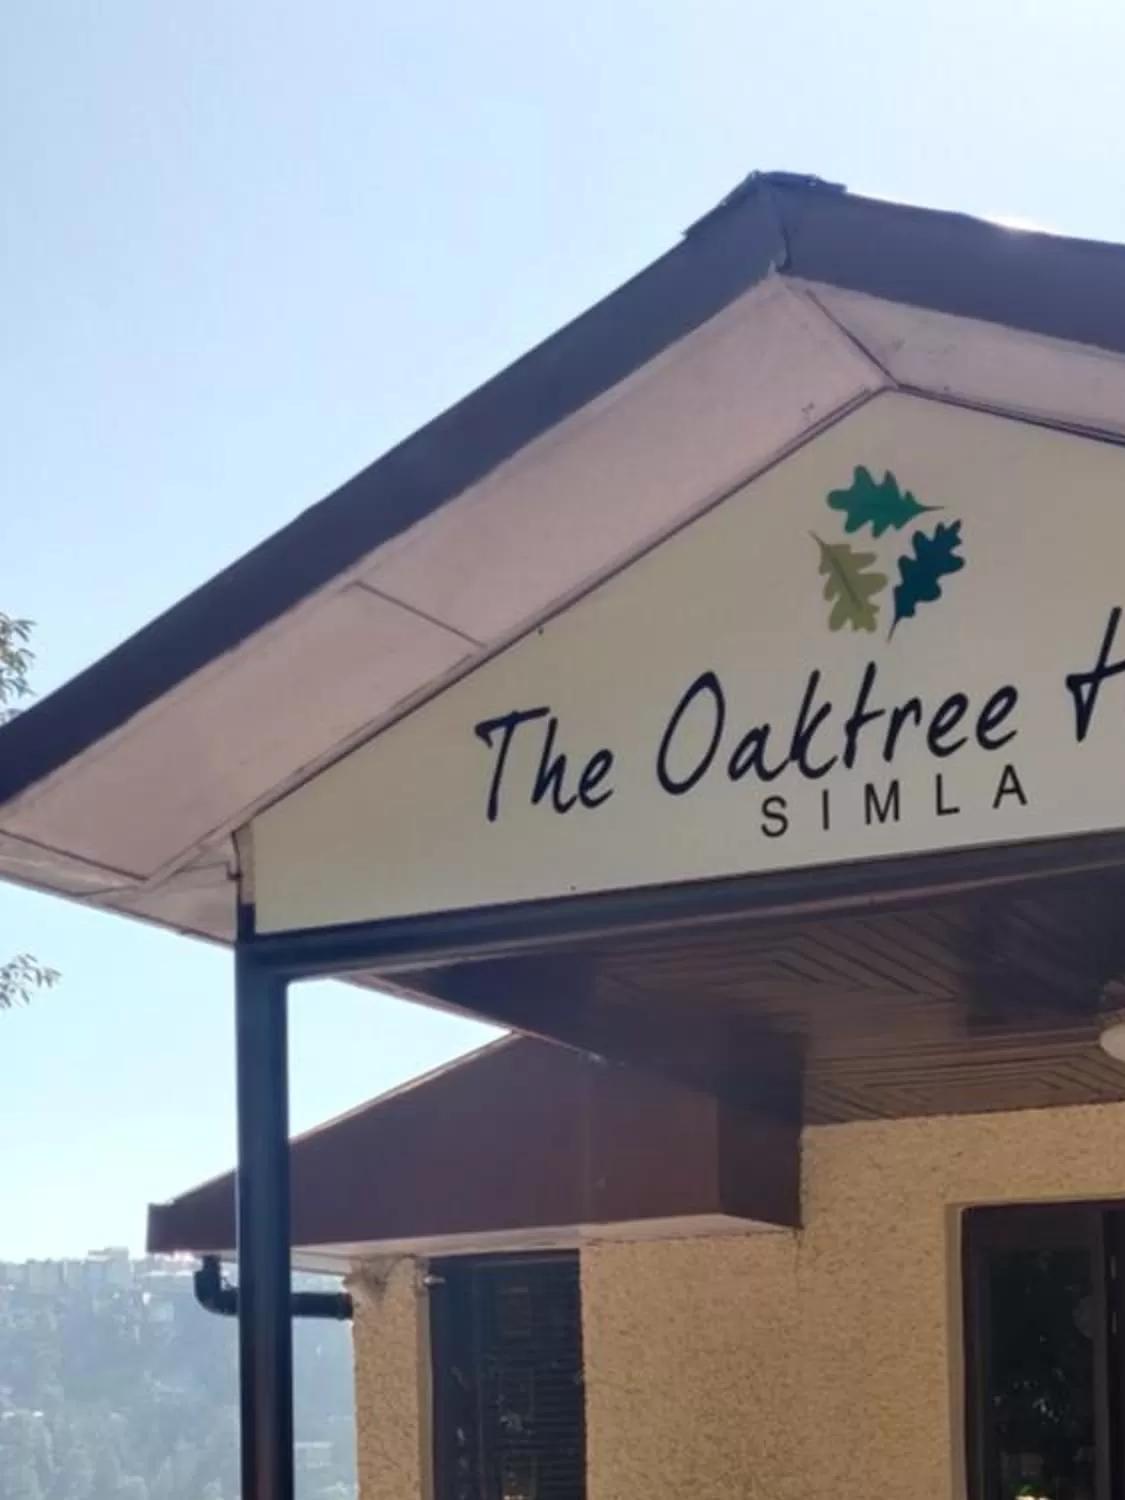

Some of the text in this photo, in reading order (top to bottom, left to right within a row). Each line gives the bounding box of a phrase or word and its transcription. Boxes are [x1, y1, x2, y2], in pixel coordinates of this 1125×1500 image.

[475, 706, 614, 822] The
[655, 660, 1019, 796] Oaktree
[760, 763, 1028, 838] SIMLA
